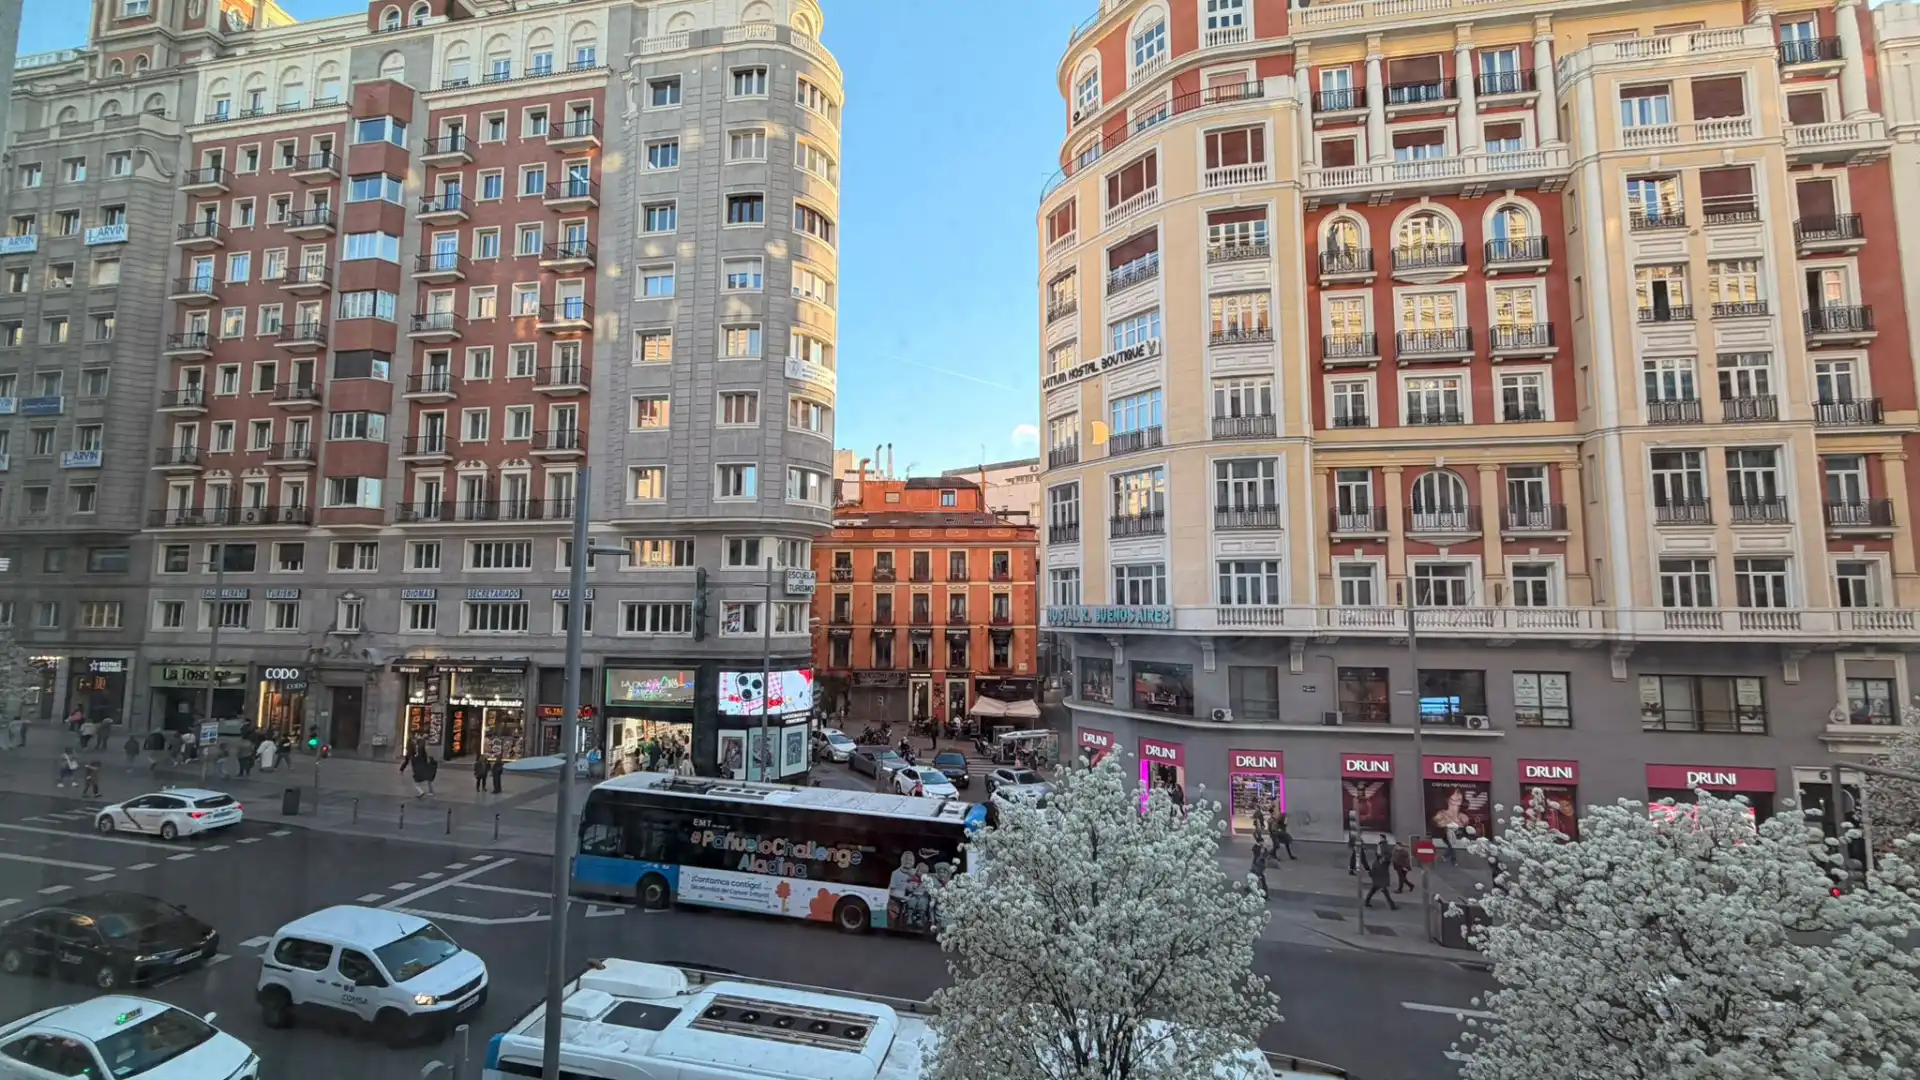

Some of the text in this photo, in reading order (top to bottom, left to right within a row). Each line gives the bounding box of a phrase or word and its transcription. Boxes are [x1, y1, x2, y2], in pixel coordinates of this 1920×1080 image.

[1069, 362, 1099, 379] HOSTAL
[1101, 345, 1145, 370] BOUTIQUE
[788, 571, 815, 579] ESCUELA
[402, 589, 434, 598] IDIOMAS
[468, 589, 520, 598] SECRETARIADO
[1095, 607, 1135, 625] BUENOS
[1137, 608, 1171, 626] AIRES
[163, 667, 178, 681] La
[265, 667, 299, 680] CODO
[1083, 732, 1107, 746] DRUNI
[1145, 745, 1176, 760] DRUNI
[1236, 755, 1277, 768] DRUNI
[1346, 759, 1390, 772] DRUNI
[1433, 762, 1478, 775] DRUNI
[1526, 765, 1573, 779] DRUNI
[1687, 771, 1736, 785] DRUNI
[693, 818, 712, 827] EMT
[737, 853, 808, 878] Aladina
